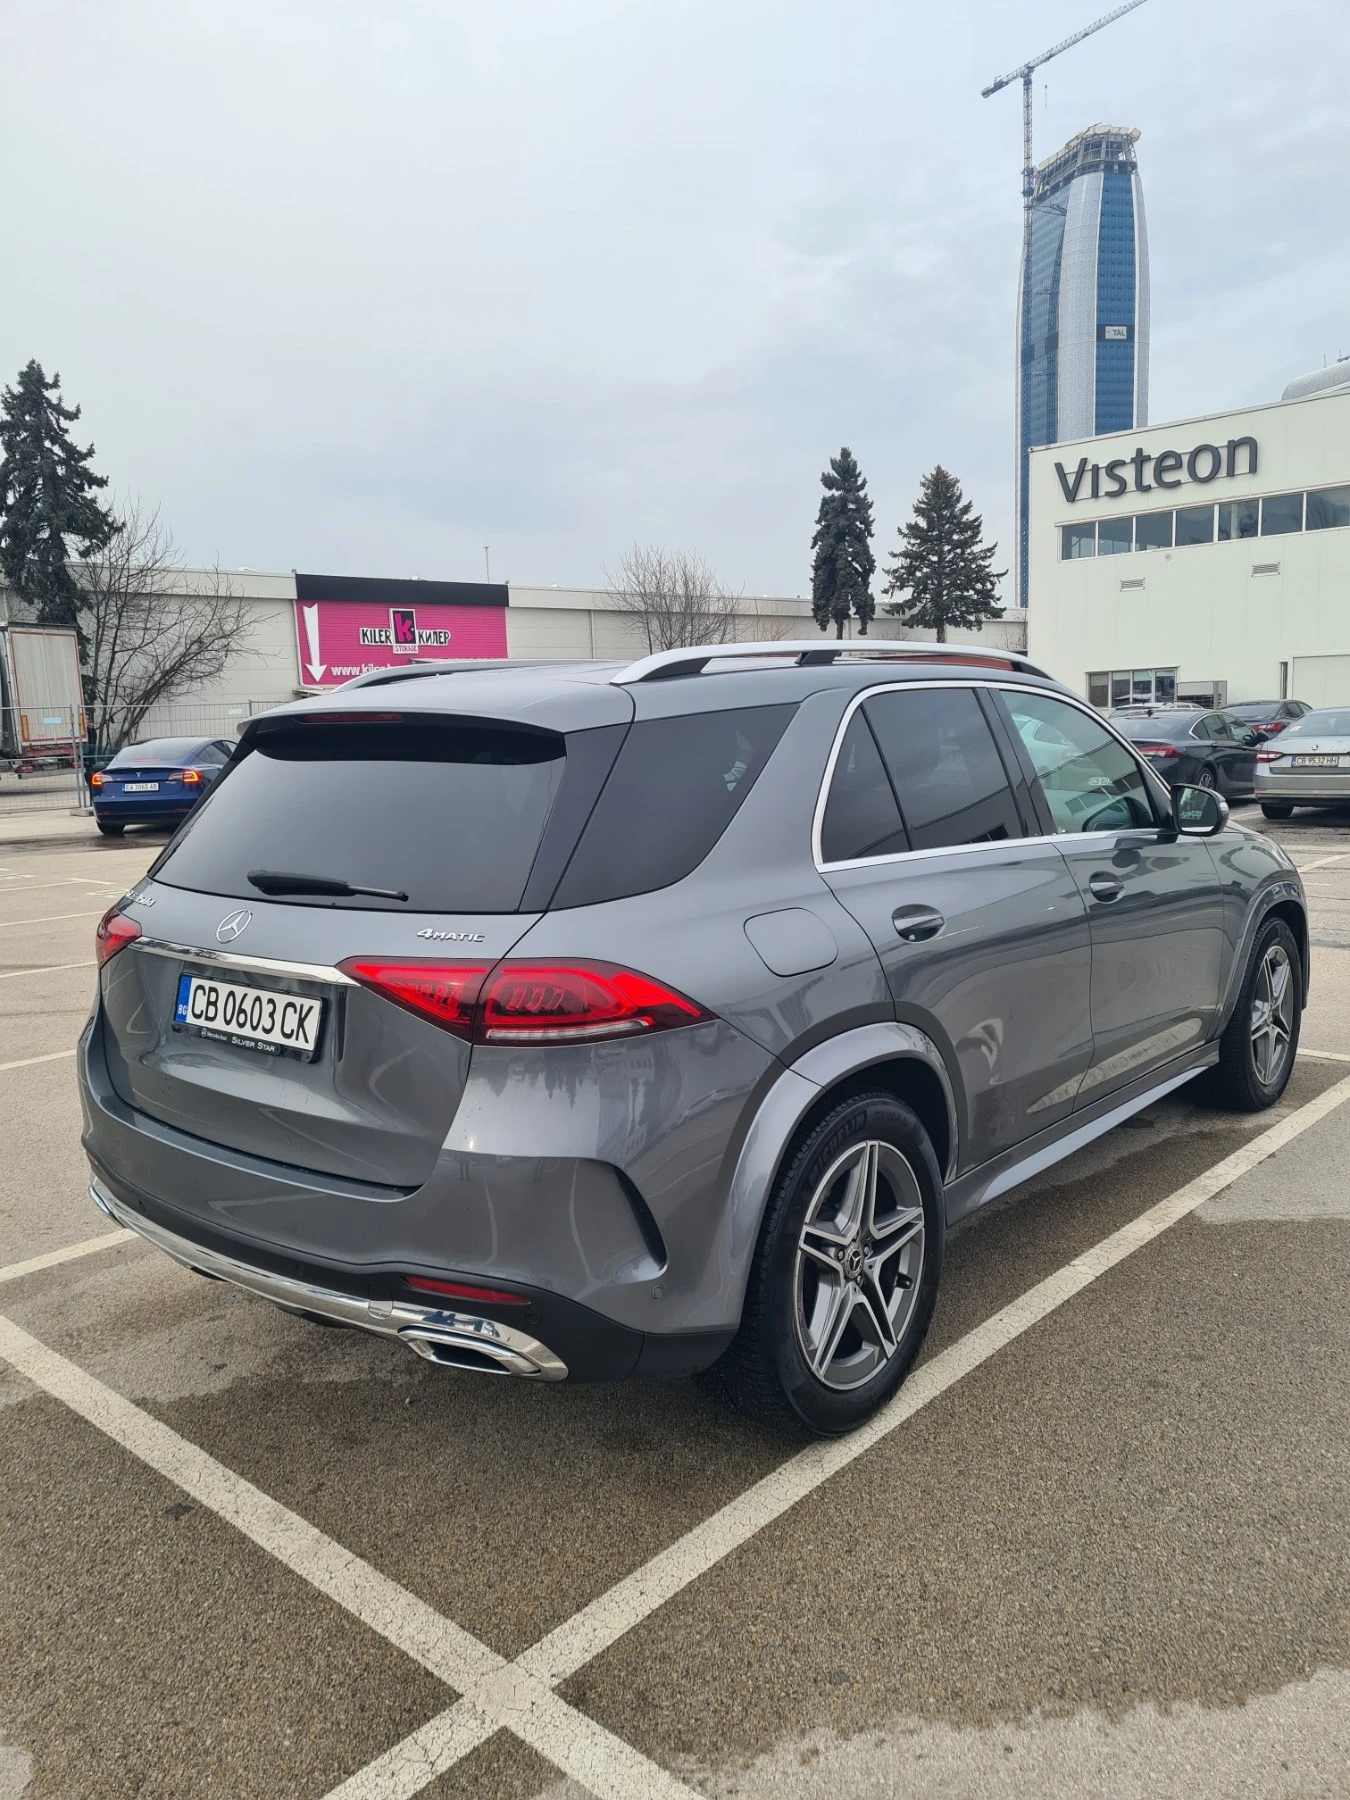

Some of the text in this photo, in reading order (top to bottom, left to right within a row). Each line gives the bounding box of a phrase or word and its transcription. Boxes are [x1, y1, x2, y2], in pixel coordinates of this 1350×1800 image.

[1054, 436, 1258, 503] Visteon
[361, 628, 392, 644] KILER
[418, 630, 451, 645] КИЛЕР
[416, 928, 486, 943] 4MATIC
[177, 1004, 188, 1015] BG
[191, 984, 315, 1044] CB 0603 CK
[231, 1036, 256, 1048] SILVER
[256, 1041, 276, 1053] STAR
